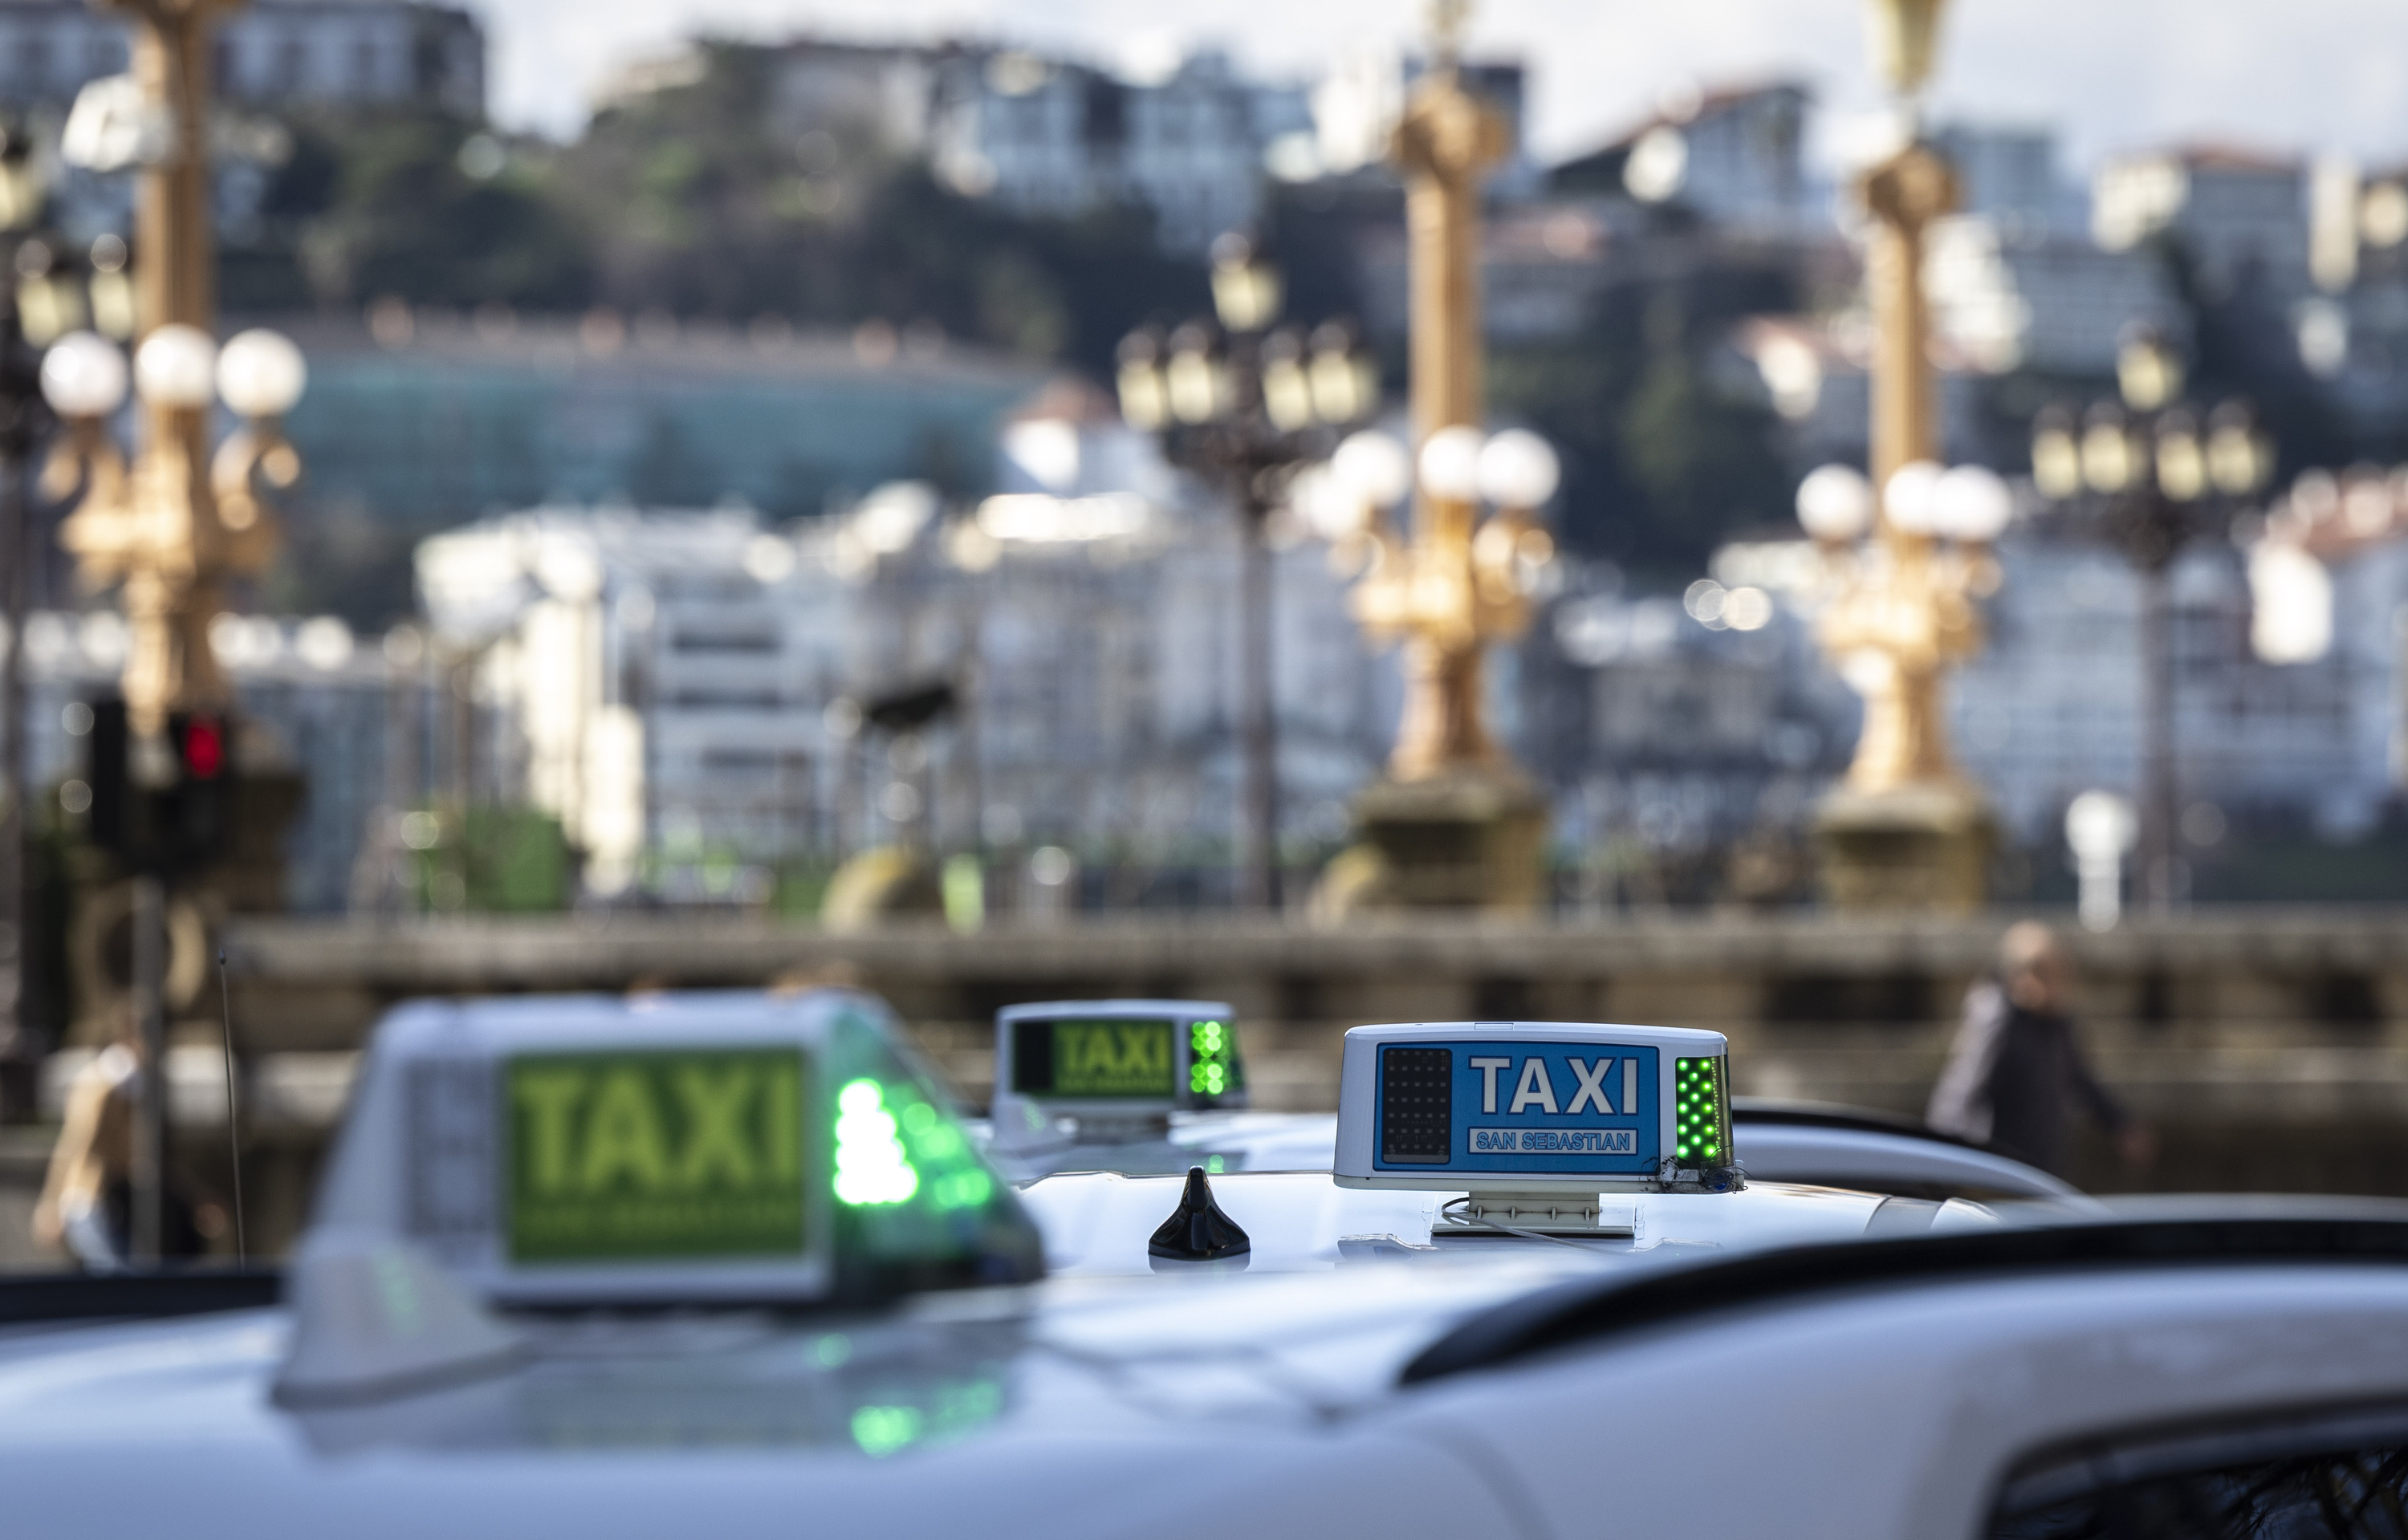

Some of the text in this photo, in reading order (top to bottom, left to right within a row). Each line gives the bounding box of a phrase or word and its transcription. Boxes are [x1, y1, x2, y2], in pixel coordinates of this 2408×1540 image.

[1057, 1027, 1168, 1071] TAXI
[1468, 1055, 1639, 1115] TAXI
[518, 1067, 798, 1192] TAXI
[1476, 1132, 1630, 1152] SAN SEBASTIAN
